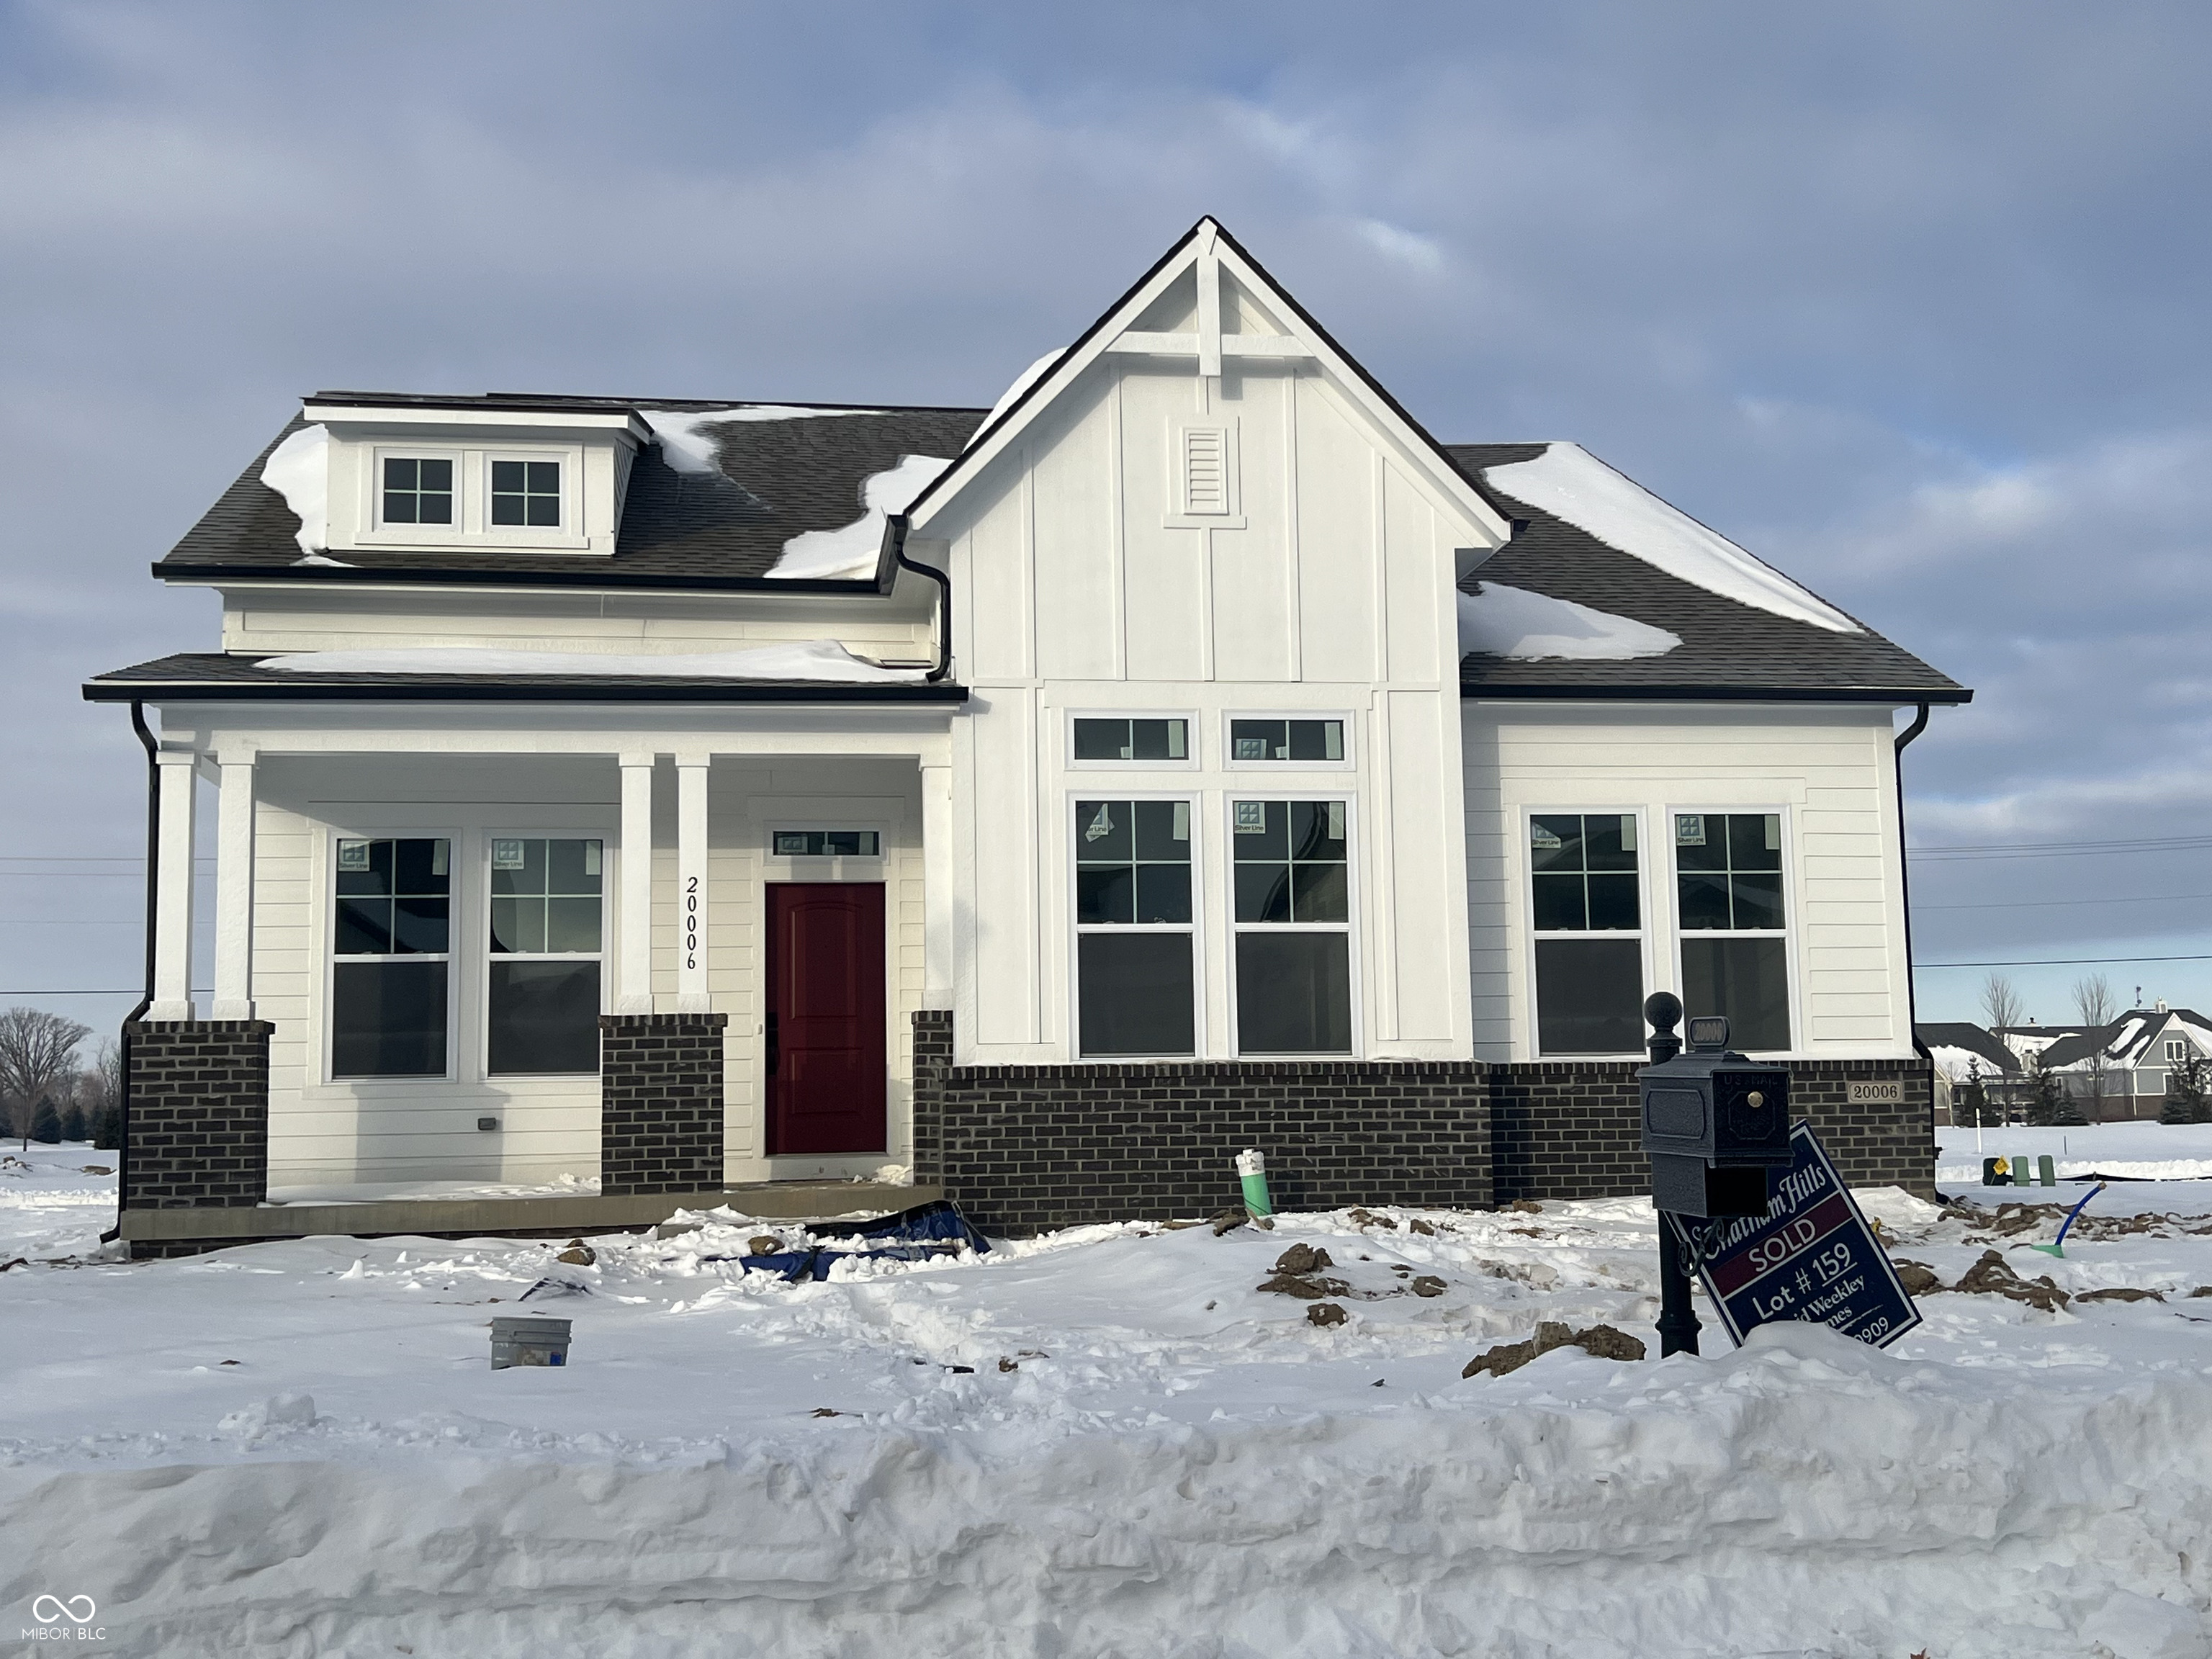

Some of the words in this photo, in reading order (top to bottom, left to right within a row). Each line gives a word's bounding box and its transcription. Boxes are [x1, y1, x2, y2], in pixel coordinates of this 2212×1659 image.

[686, 876, 698, 969] 20006
[1854, 1085, 1897, 1099] 20006
[1779, 1164, 1826, 1213] Hills
[1749, 1219, 1815, 1272] SOLD
[1753, 1286, 1795, 1320] Lot
[1795, 1267, 1811, 1294] #
[1812, 1243, 1851, 1281] 159
[1808, 1275, 1865, 1316] Weekley
